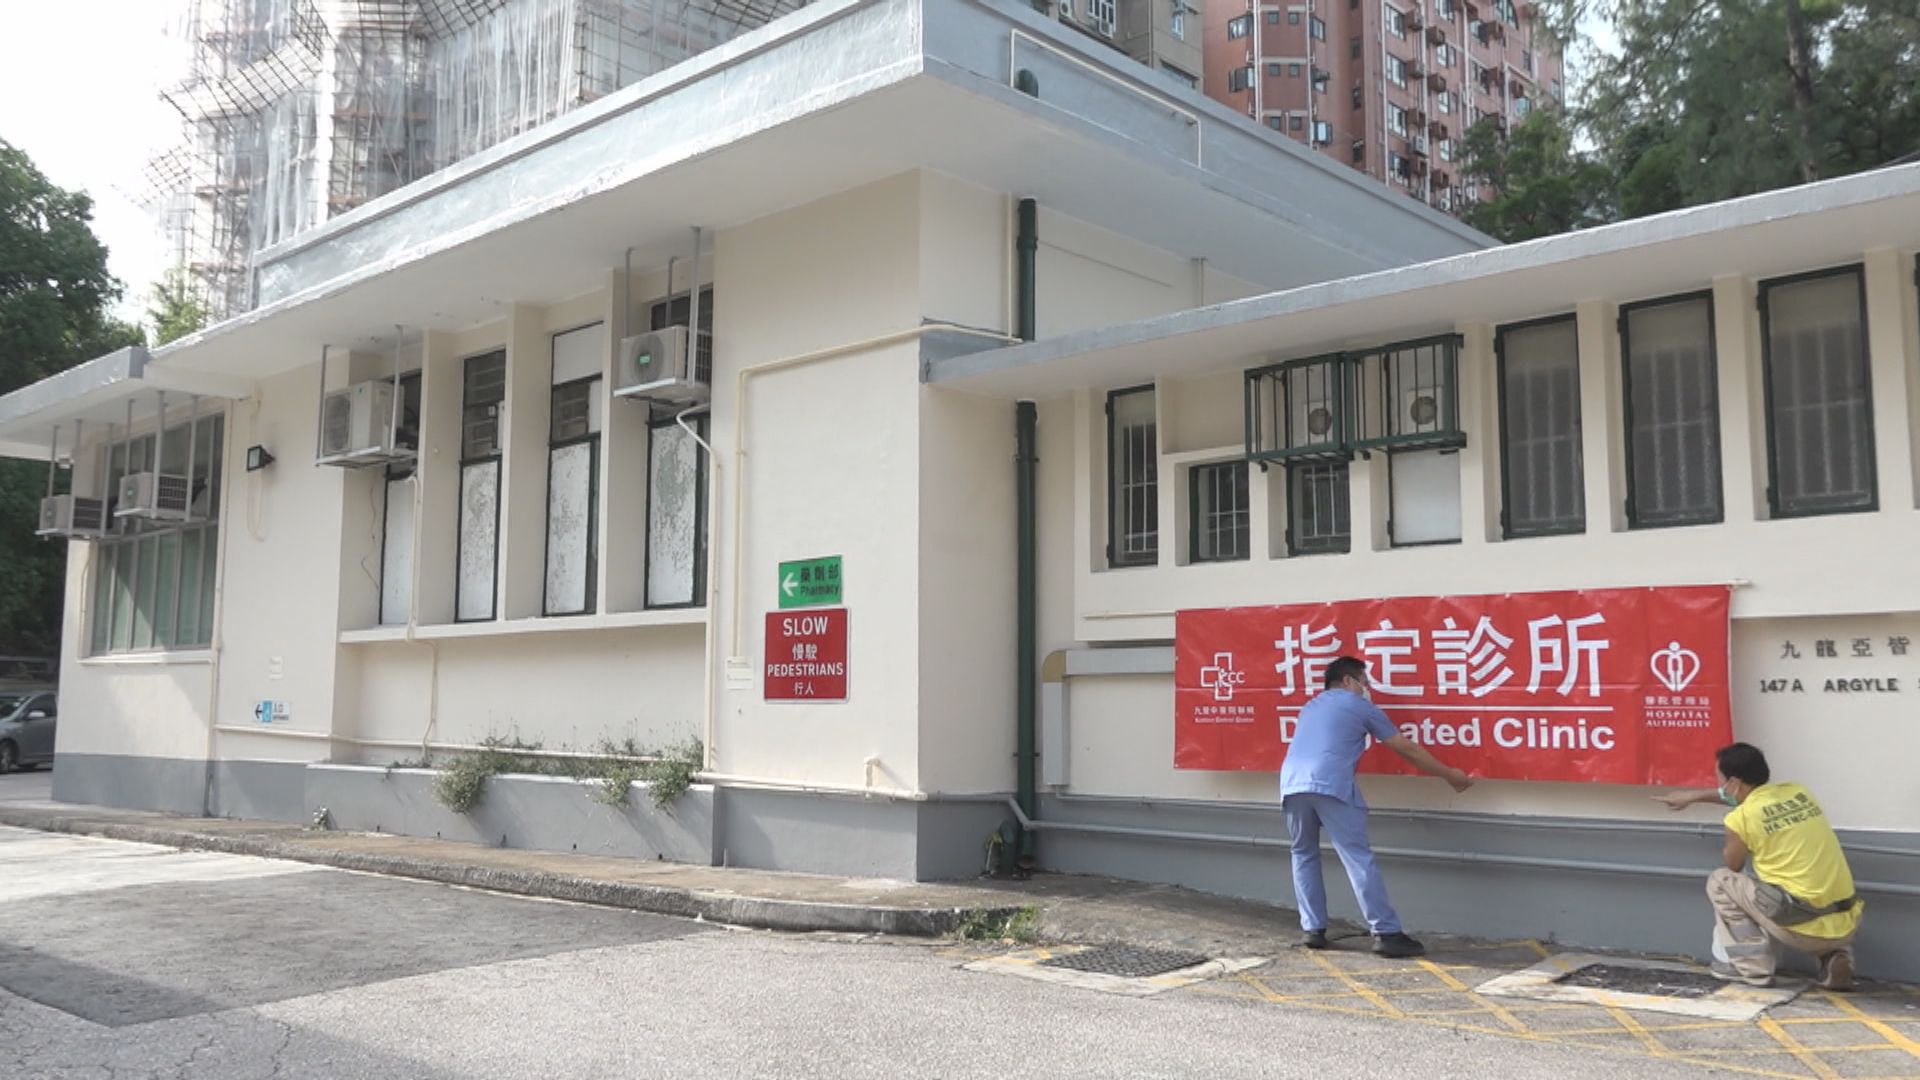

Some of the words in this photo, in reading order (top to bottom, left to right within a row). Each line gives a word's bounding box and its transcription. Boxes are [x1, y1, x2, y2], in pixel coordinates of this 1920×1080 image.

[783, 616, 828, 637] SLOW
[767, 662, 844, 678] PEDESTRIANS
[793, 681, 815, 696] 行人
[1824, 677, 1899, 693] ARGYLE
[1645, 710, 1711, 719] HOSPITAL
[1647, 719, 1711, 728] AUTHORITY
[1279, 715, 1481, 750] Dated
[1493, 717, 1615, 750] Clinic
